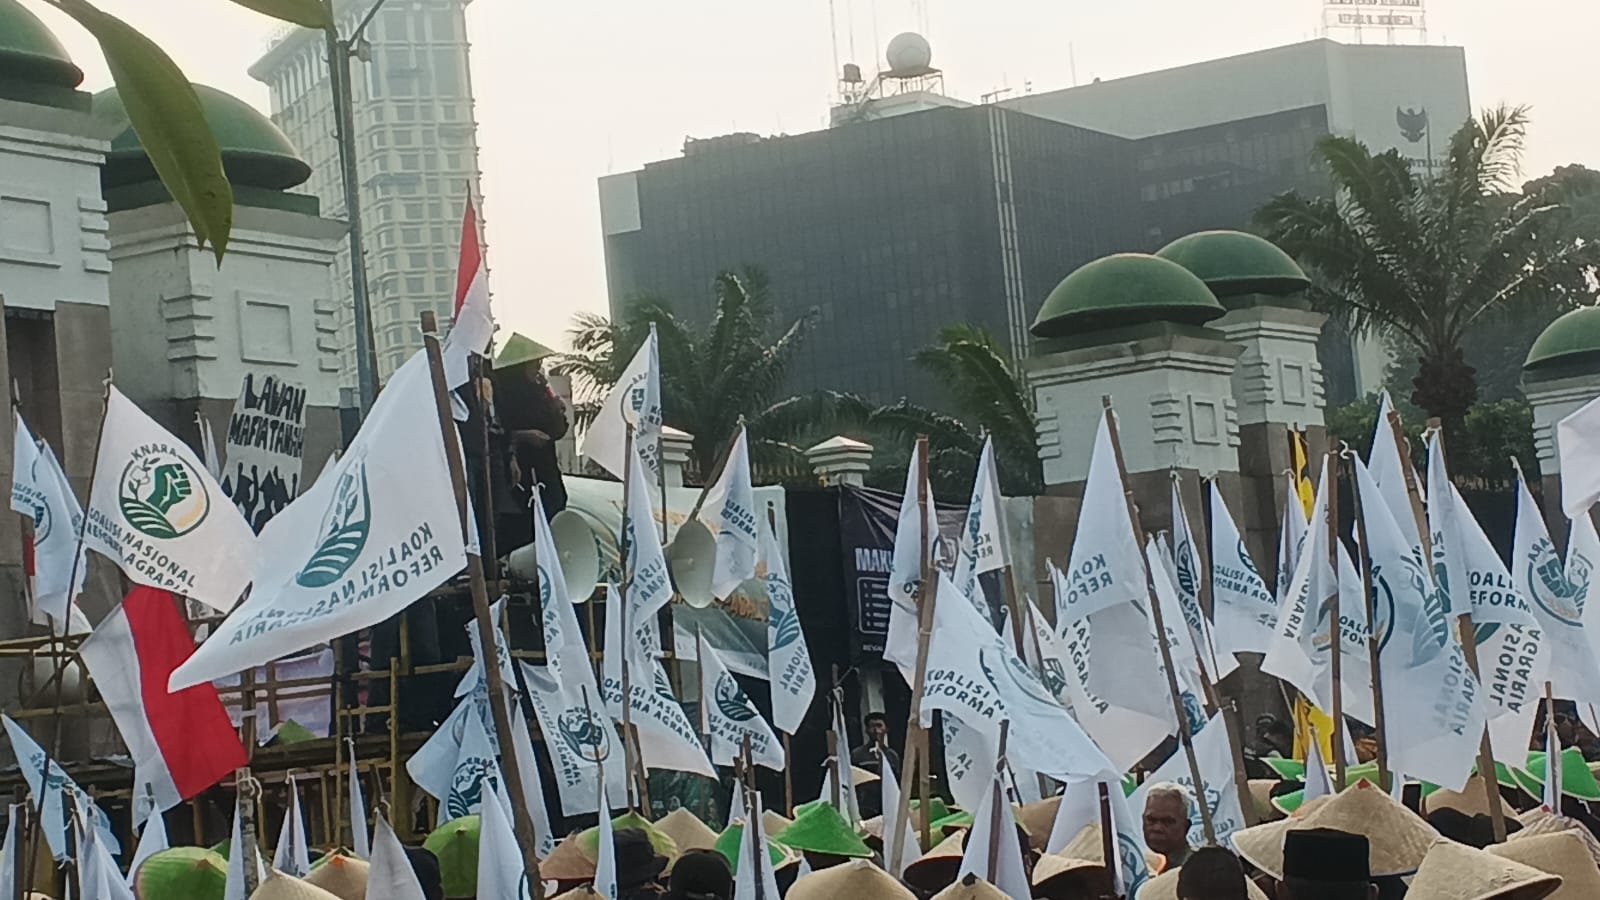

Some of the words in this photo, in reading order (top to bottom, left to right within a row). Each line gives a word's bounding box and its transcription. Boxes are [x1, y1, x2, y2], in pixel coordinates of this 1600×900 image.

[244, 373, 306, 424] LAWAN
[228, 413, 269, 450] MAFIA
[131, 443, 177, 461] KNARA
[123, 532, 196, 588] NASIONAL
[1467, 571, 1513, 590] OALI
[1470, 590, 1531, 613] EFORM
[1068, 640, 1109, 714] AGRAIA
[604, 690, 650, 713] FOMA
[604, 678, 646, 698] OAISI
[648, 694, 691, 732] NASION
